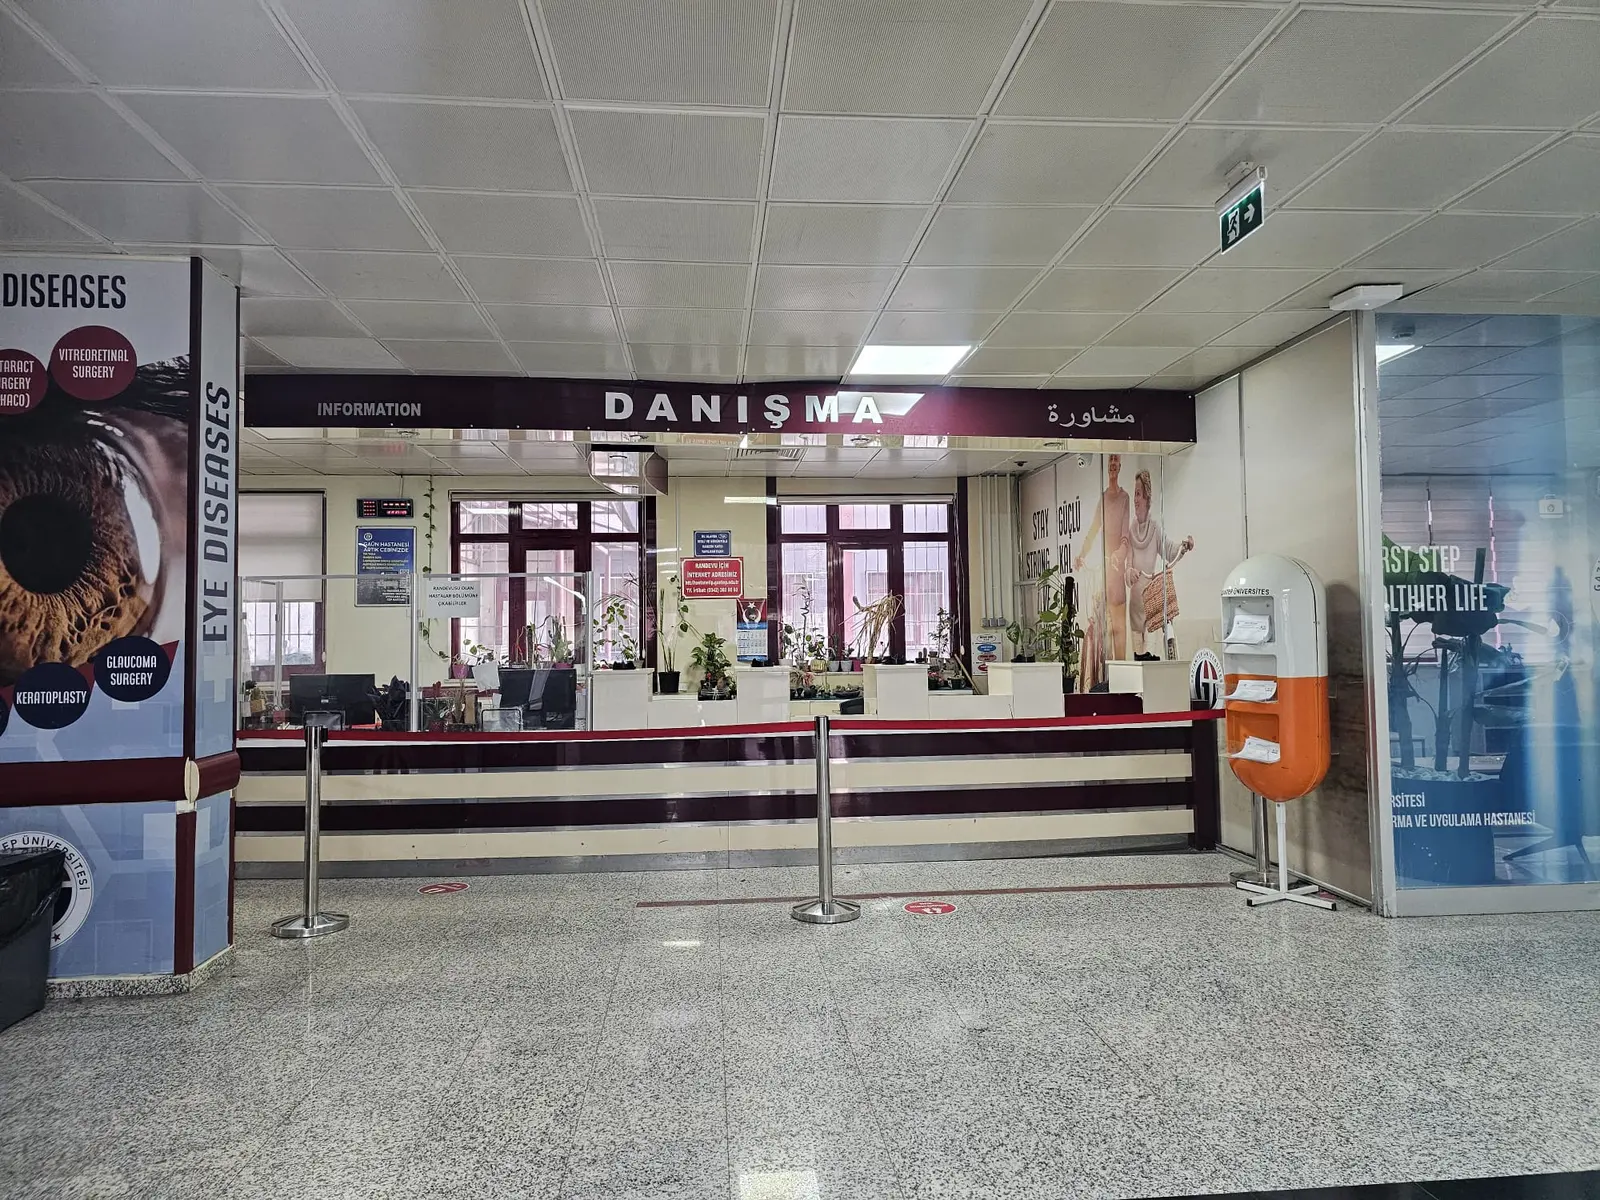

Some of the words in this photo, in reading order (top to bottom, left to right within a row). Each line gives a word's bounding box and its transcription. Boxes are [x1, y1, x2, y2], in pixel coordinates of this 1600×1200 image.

[3, 273, 127, 309] DISEASES
[58, 348, 129, 362] VITREORETINAL
[72, 365, 115, 379] SURGERY
[317, 401, 422, 417] INFORMATION
[604, 391, 884, 429] DANIŞMA
[1047, 403, 1135, 428] مشاورة
[204, 381, 230, 563] DISEASES
[1032, 508, 1050, 541] STAY
[1058, 496, 1081, 540] GÜÇLÜ
[1059, 543, 1073, 574] KAL
[1418, 545, 1461, 573] STEP
[203, 579, 228, 641] EYE
[1455, 584, 1488, 611] LIFE
[107, 655, 157, 669] GLAUCOMA
[110, 672, 153, 686] SURGERY
[16, 690, 87, 705] KERATOPLASTY
[1392, 815, 1413, 828] RMA
[1414, 814, 1428, 827] VE
[1429, 813, 1482, 827] UYGULAMA
[1484, 810, 1536, 826] HASTANESİ
